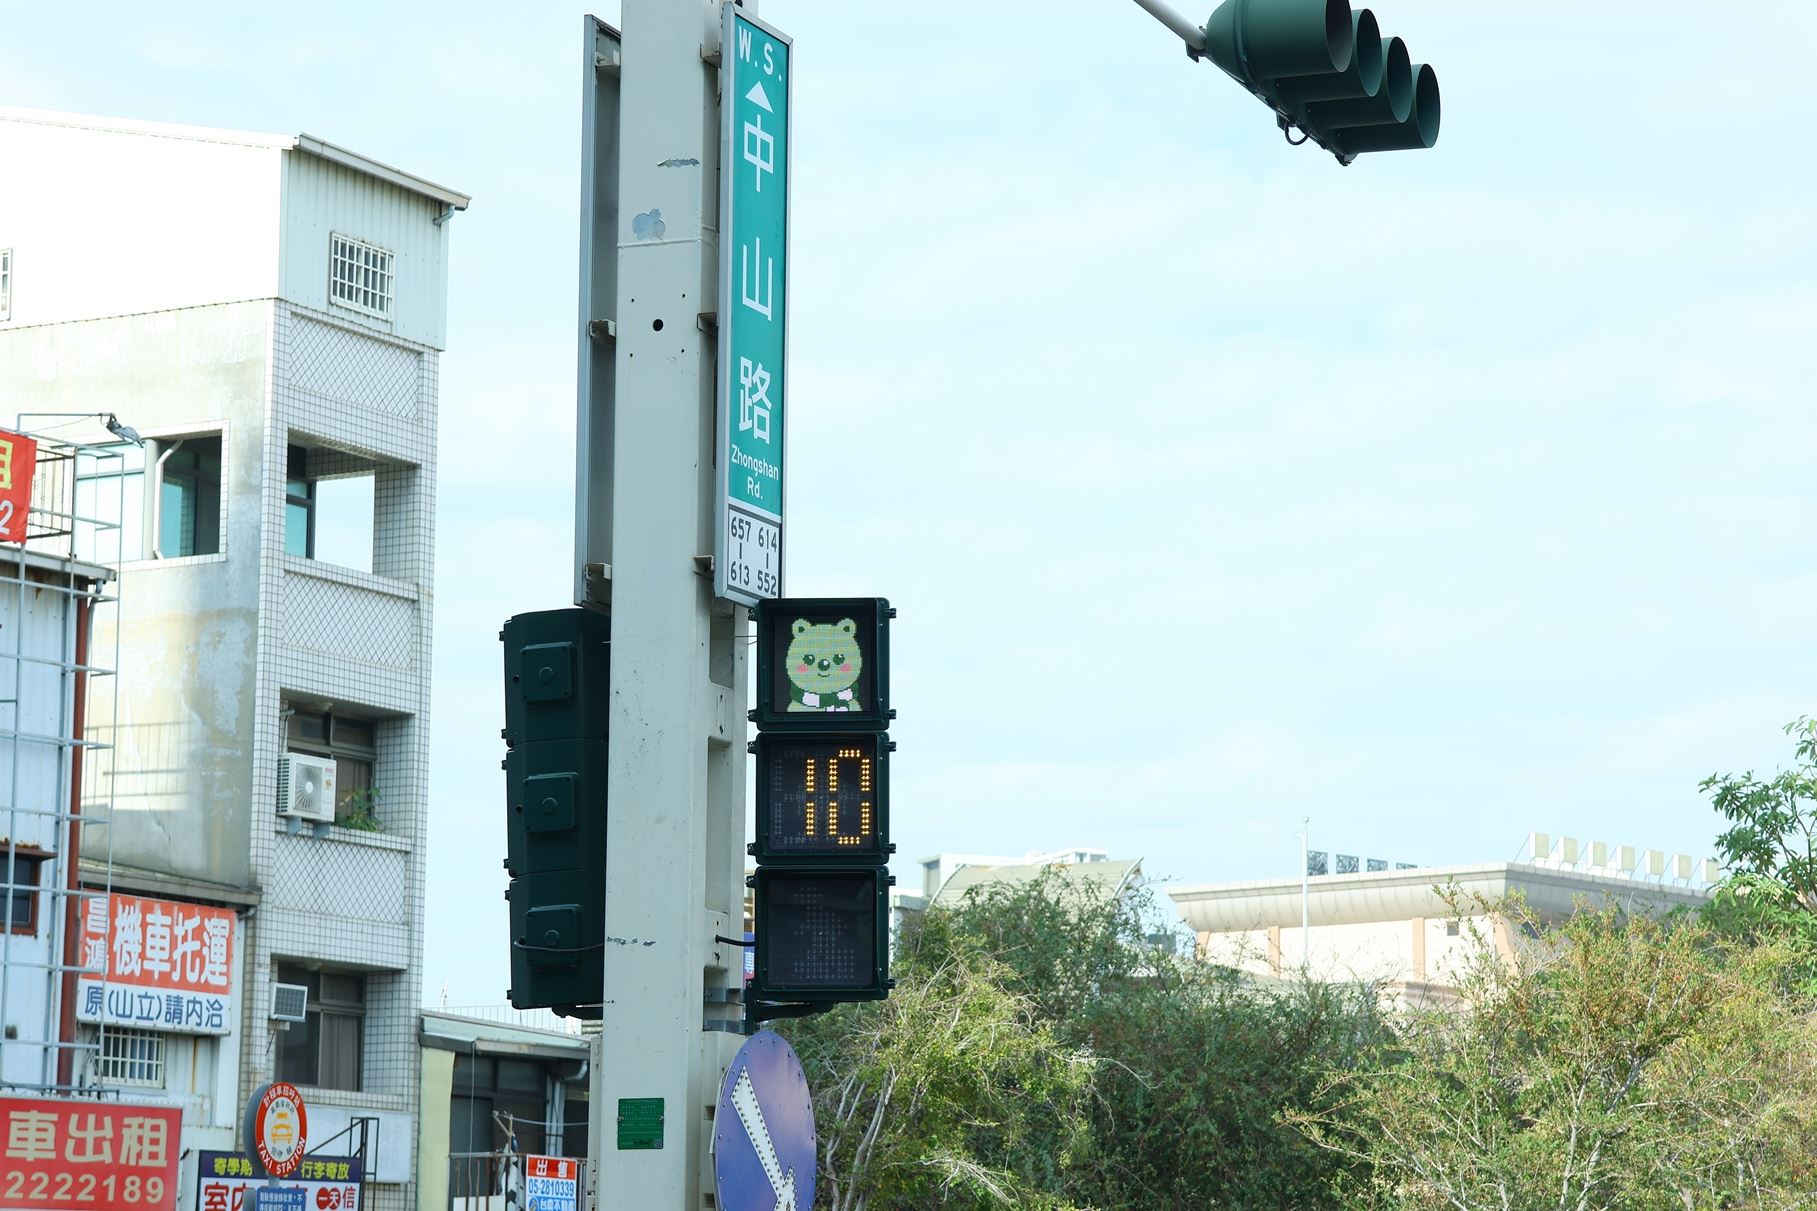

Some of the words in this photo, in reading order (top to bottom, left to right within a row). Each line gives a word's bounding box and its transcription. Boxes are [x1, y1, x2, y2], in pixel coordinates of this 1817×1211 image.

[739, 114, 775, 444] 中山路
[731, 444, 779, 481] Zhongshan
[747, 476, 763, 499] Rd.
[731, 520, 752, 544] 657
[758, 528, 777, 553] 614
[730, 561, 750, 587] 613
[757, 571, 777, 596] 552
[806, 749, 871, 845] 10
[113, 903, 230, 986] 機車托運
[5, 1110, 168, 1167] 車出租
[258, 1140, 273, 1169] TAXI
[276, 1136, 306, 1175] STATION
[4, 1170, 164, 1204] 2222189
[528, 1178, 574, 1197] 05-2810339
